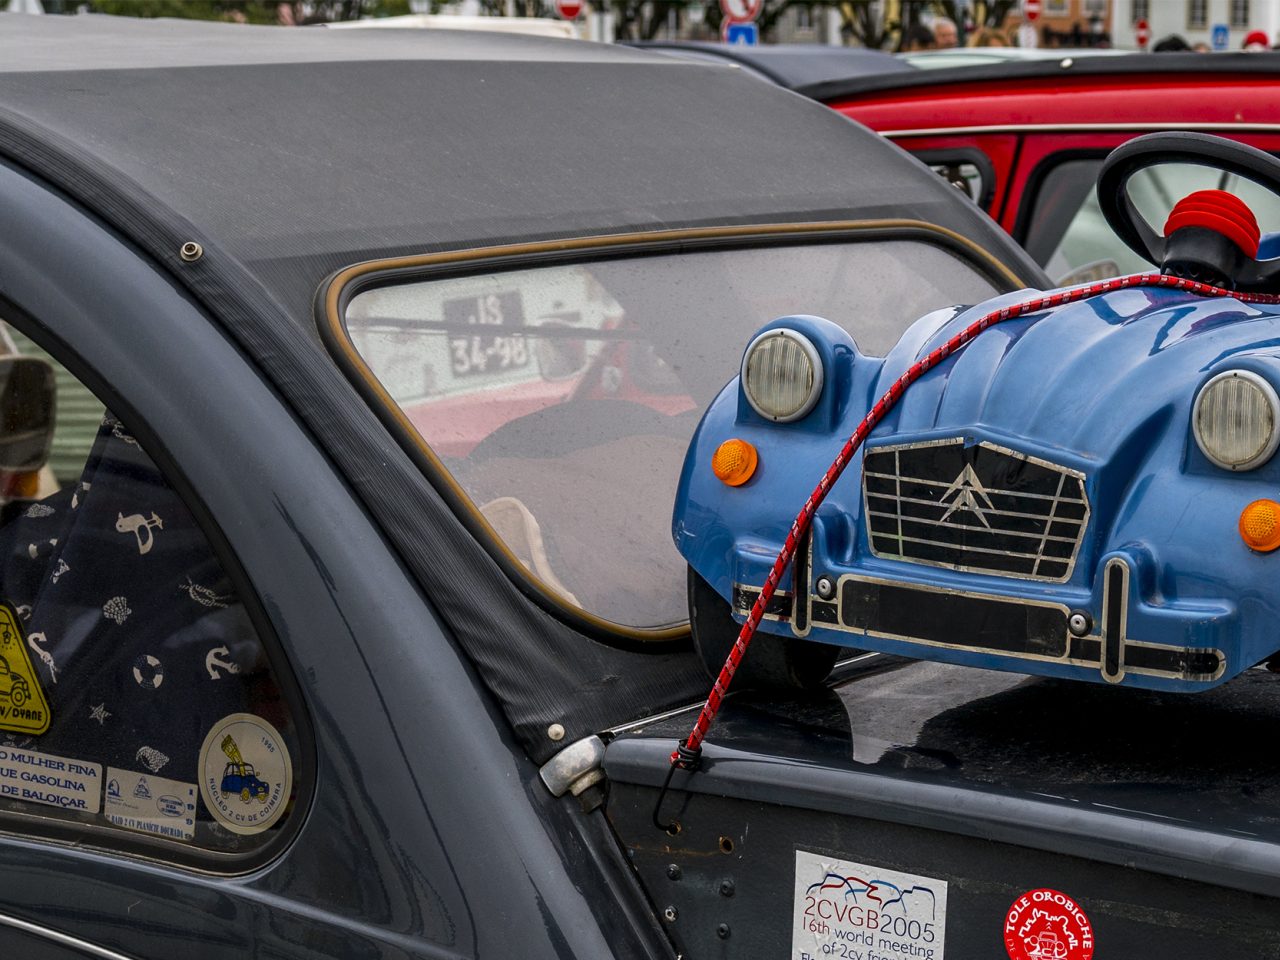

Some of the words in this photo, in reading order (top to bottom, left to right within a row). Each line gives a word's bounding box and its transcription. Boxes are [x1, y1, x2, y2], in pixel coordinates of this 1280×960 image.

[10, 752, 65, 772] MULHER
[68, 763, 97, 777] FINA
[1, 784, 19, 796] DE
[20, 772, 86, 792] GASOLINA
[248, 813, 258, 822] DE
[259, 782, 282, 817] COIMBRA
[802, 916, 830, 936] 16th
[834, 928, 874, 947] world
[804, 896, 936, 943] 2CVGB2005
[1005, 896, 1031, 933] TOLE
[1032, 891, 1092, 949] OROBICHE
[822, 941, 836, 955] of
[840, 943, 863, 960] 2cv
